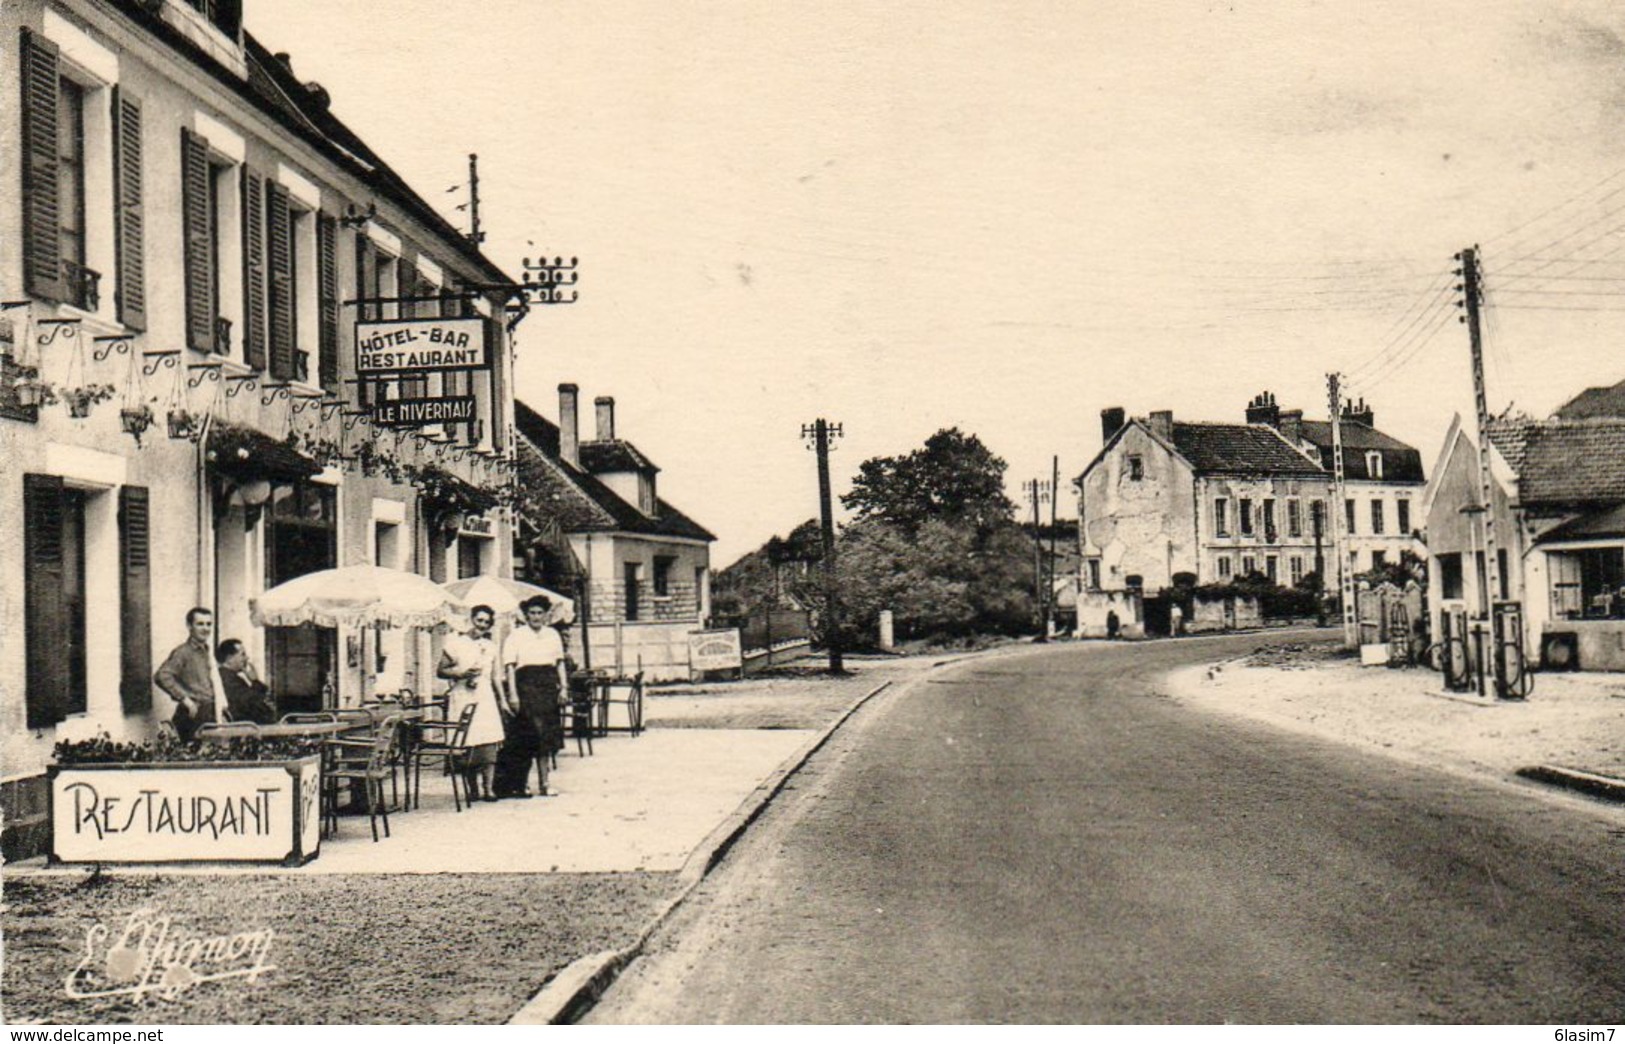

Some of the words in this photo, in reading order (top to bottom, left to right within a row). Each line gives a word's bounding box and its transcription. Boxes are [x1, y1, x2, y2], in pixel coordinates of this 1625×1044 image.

[360, 328, 470, 354] HÔTEL-BAR
[360, 350, 478, 368] RESTAURANT
[378, 407, 395, 422] LE
[400, 401, 473, 421] NIVERNAIS
[64, 782, 281, 840] RESTAURANT
